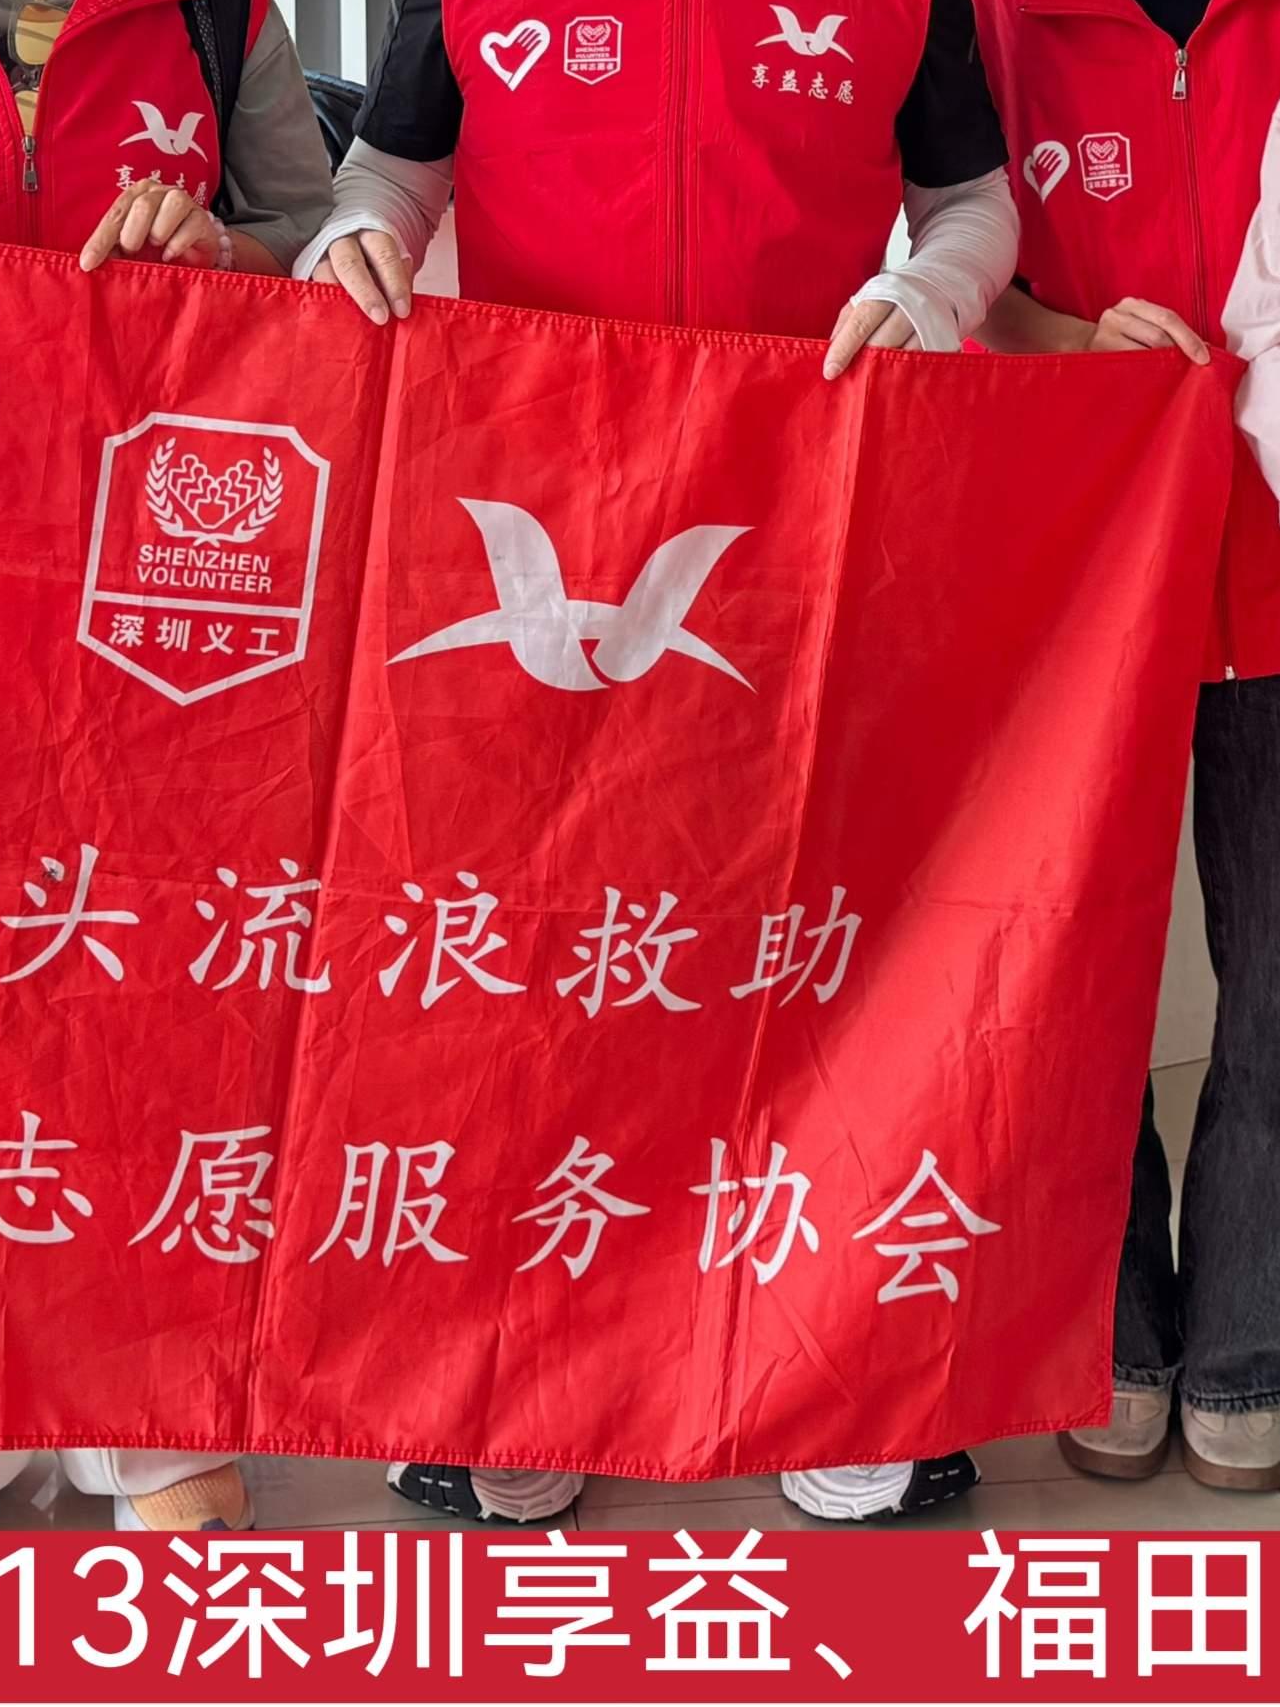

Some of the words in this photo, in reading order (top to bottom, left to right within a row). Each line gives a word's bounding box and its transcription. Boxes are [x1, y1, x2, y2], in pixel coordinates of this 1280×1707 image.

[751, 62, 855, 106] 享益志愿
[138, 543, 271, 574] SHENZHEN
[136, 564, 273, 595] VOLUNTEER
[107, 612, 281, 657] 深圳义工
